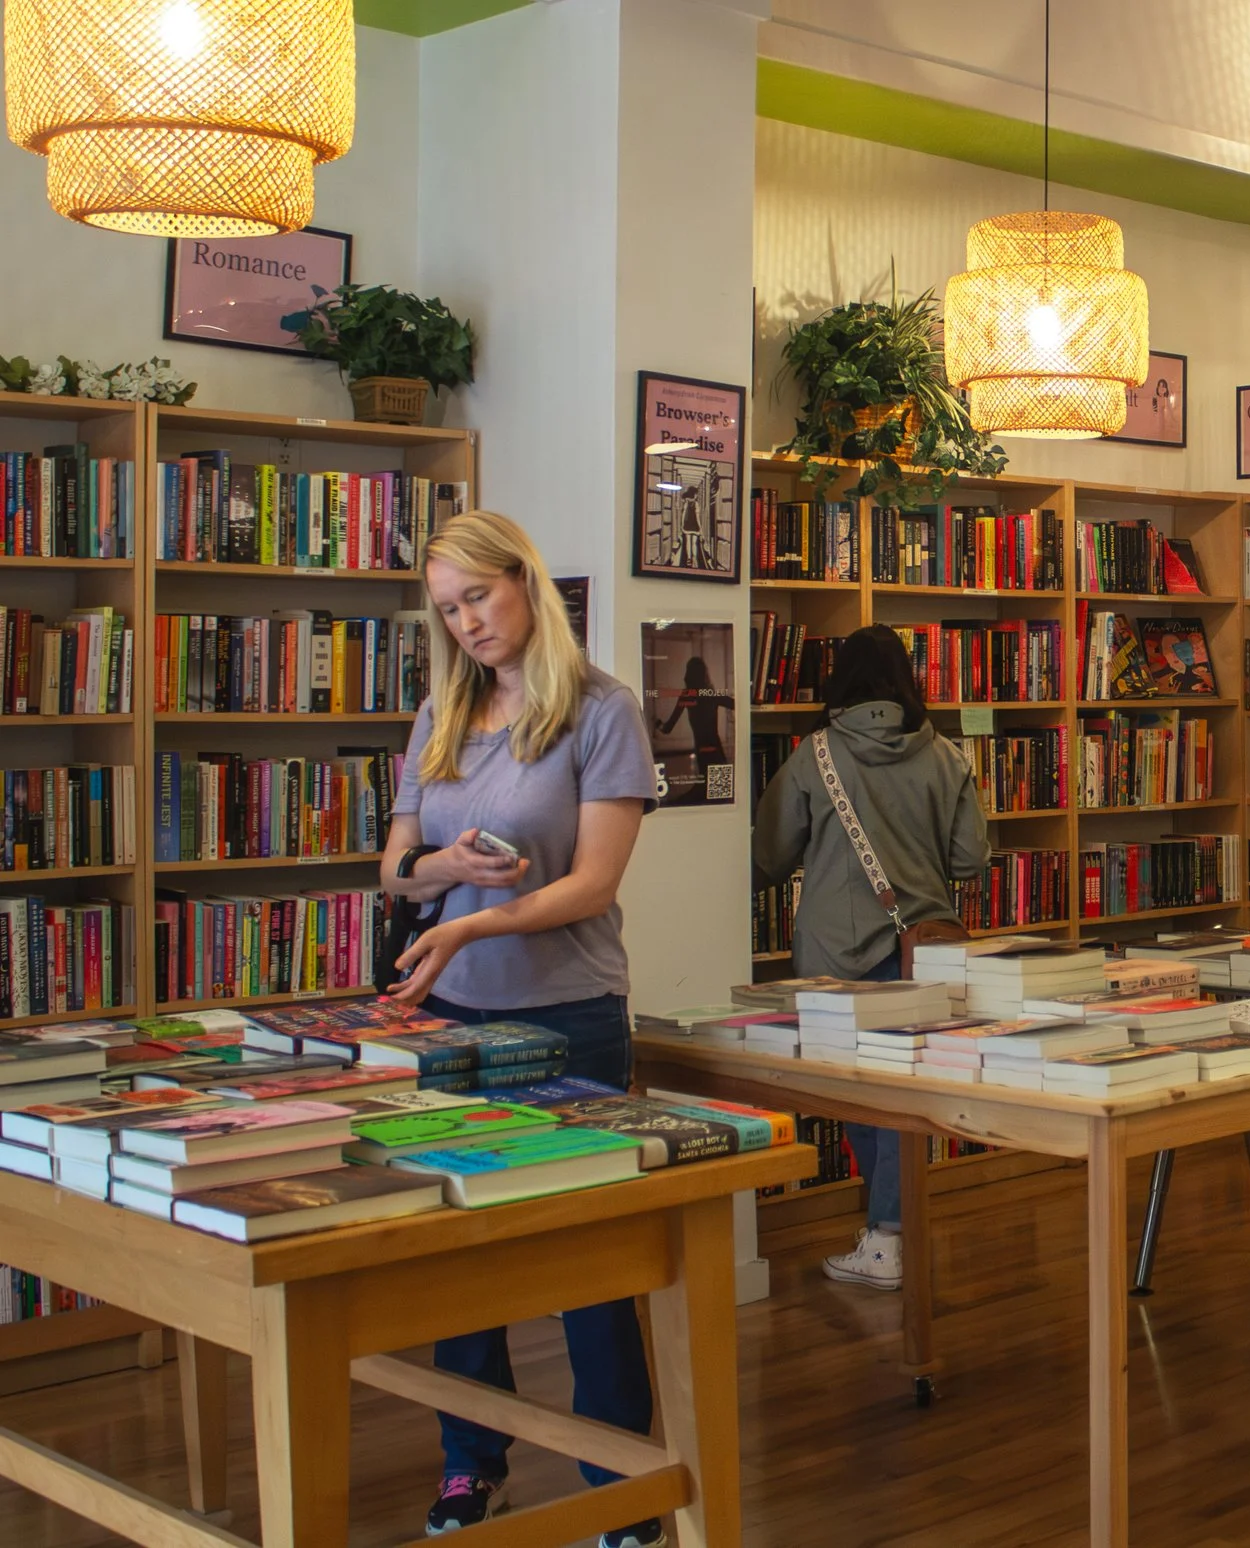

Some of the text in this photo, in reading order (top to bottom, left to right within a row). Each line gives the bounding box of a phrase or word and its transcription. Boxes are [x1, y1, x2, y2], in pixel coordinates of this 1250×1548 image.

[192, 242, 307, 282] Romance
[656, 401, 730, 427] Browser's
[645, 689, 659, 697] THE
[698, 688, 729, 697] PROJECT
[160, 754, 172, 828] INFINITE JEST
[366, 814, 375, 842] OURS
